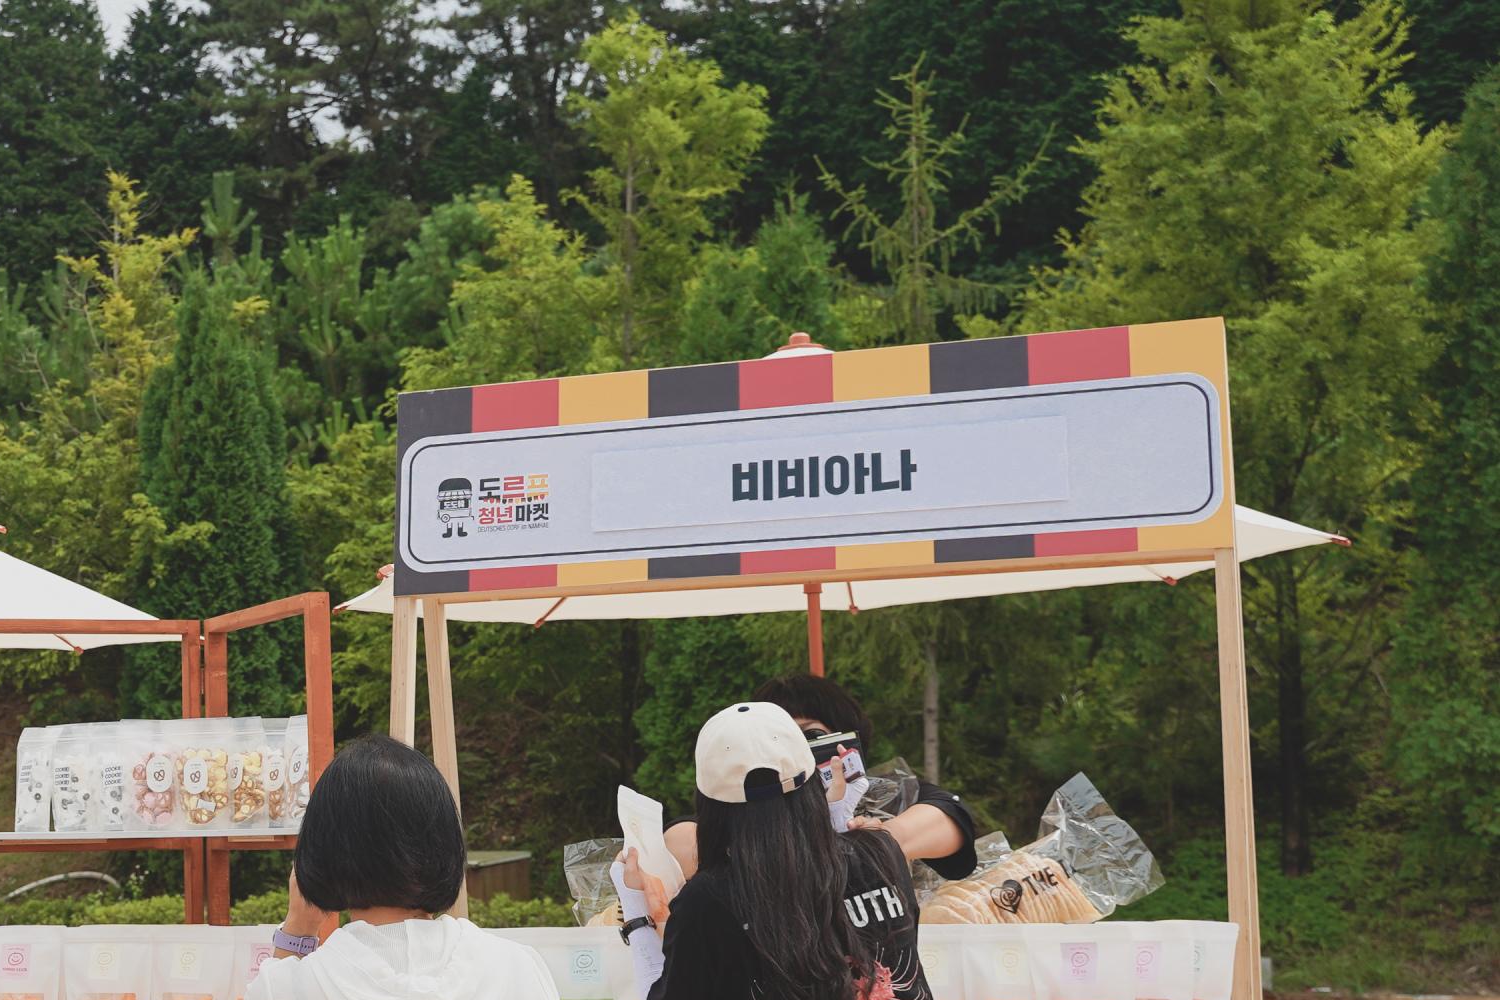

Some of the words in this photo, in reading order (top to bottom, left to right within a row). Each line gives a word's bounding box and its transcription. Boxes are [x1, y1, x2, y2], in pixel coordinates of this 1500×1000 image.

[478, 473, 549, 502] 도르프
[732, 448, 918, 502] 비비아나
[478, 503, 549, 525] 청년마켓
